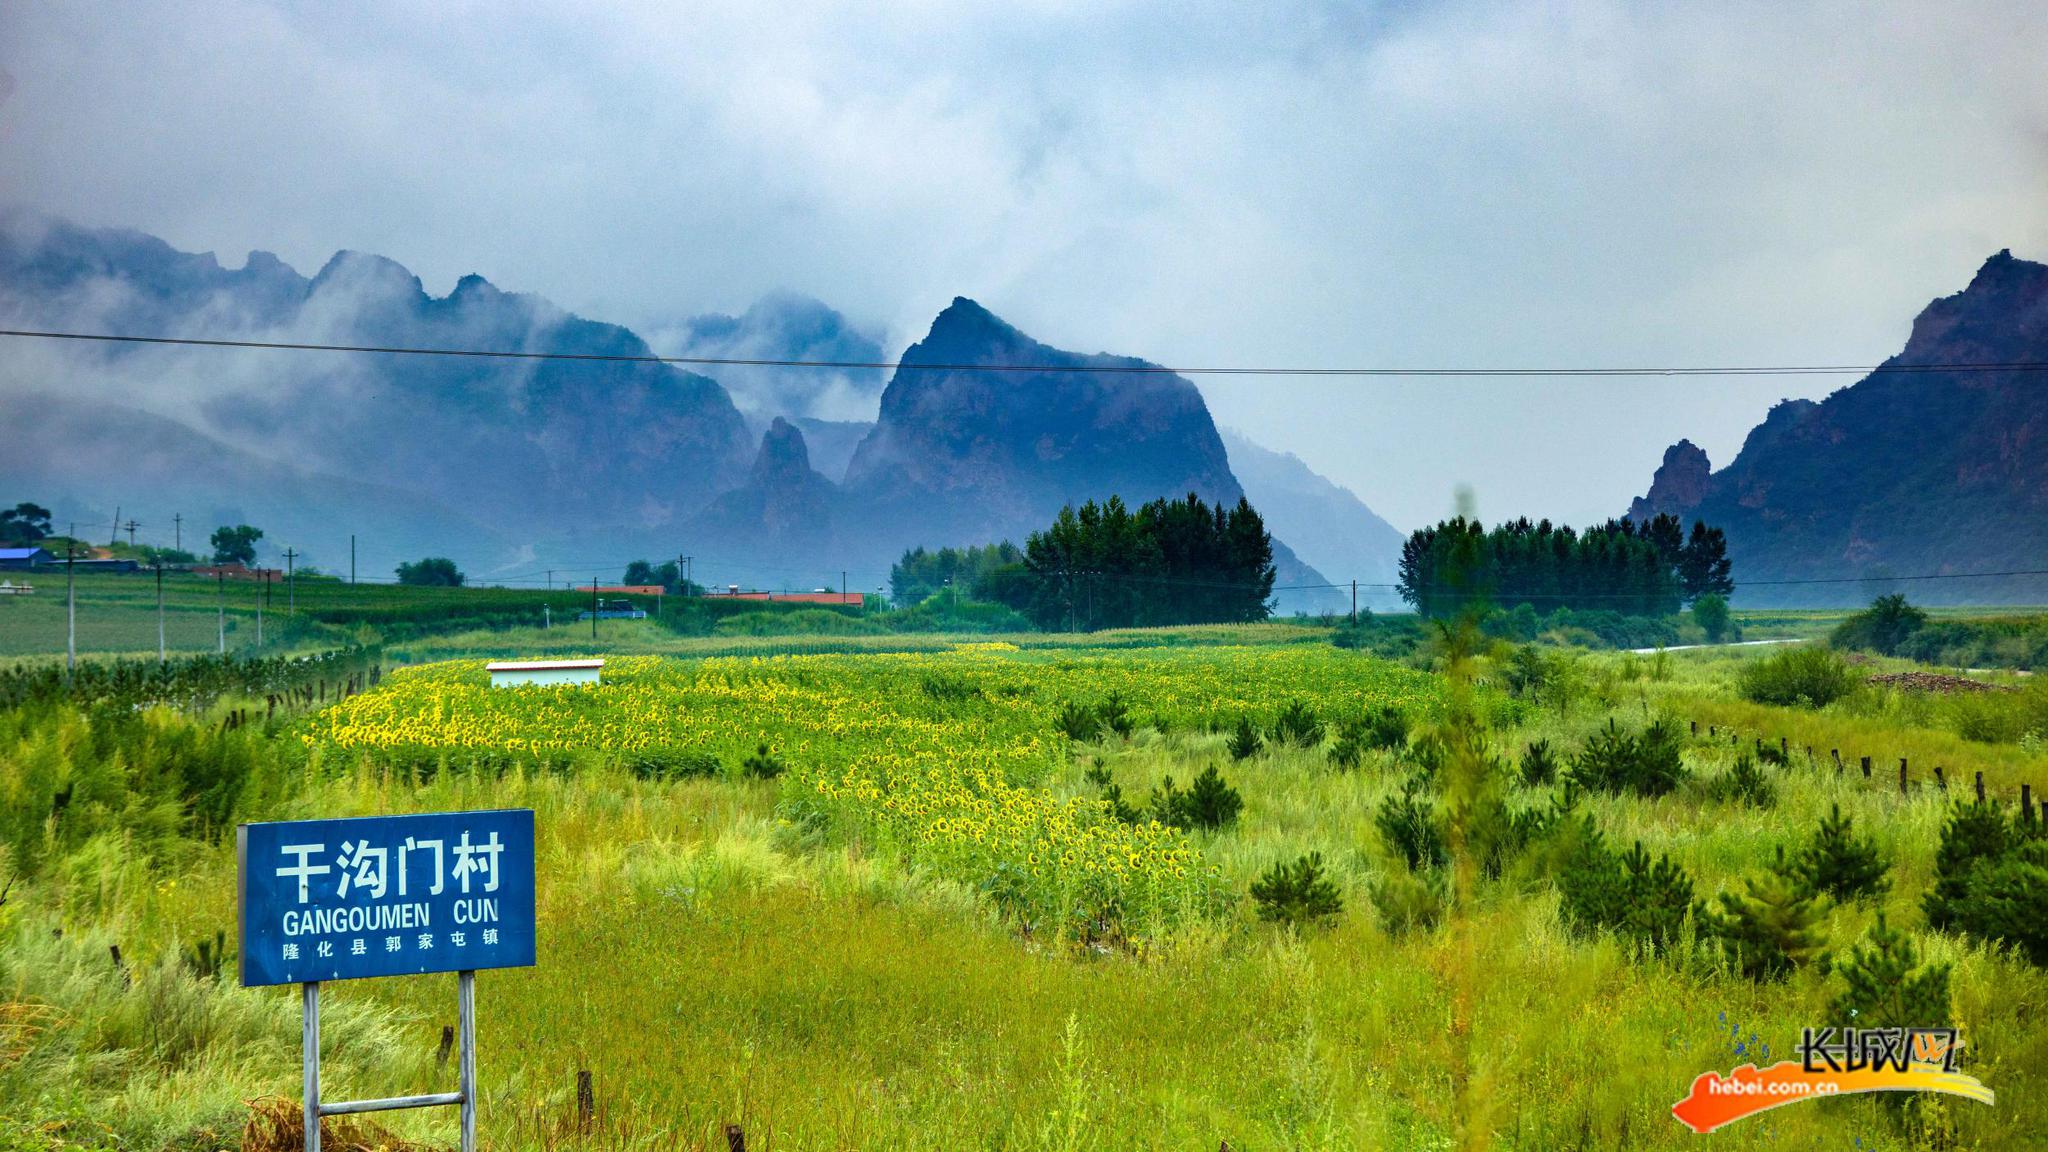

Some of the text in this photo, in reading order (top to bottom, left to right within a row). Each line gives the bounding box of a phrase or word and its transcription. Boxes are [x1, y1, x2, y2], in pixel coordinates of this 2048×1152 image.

[276, 831, 504, 904] 干沟门村
[282, 898, 498, 936] GANGOUMEN CUN
[282, 928, 499, 961] 隆化县郭家屯镇
